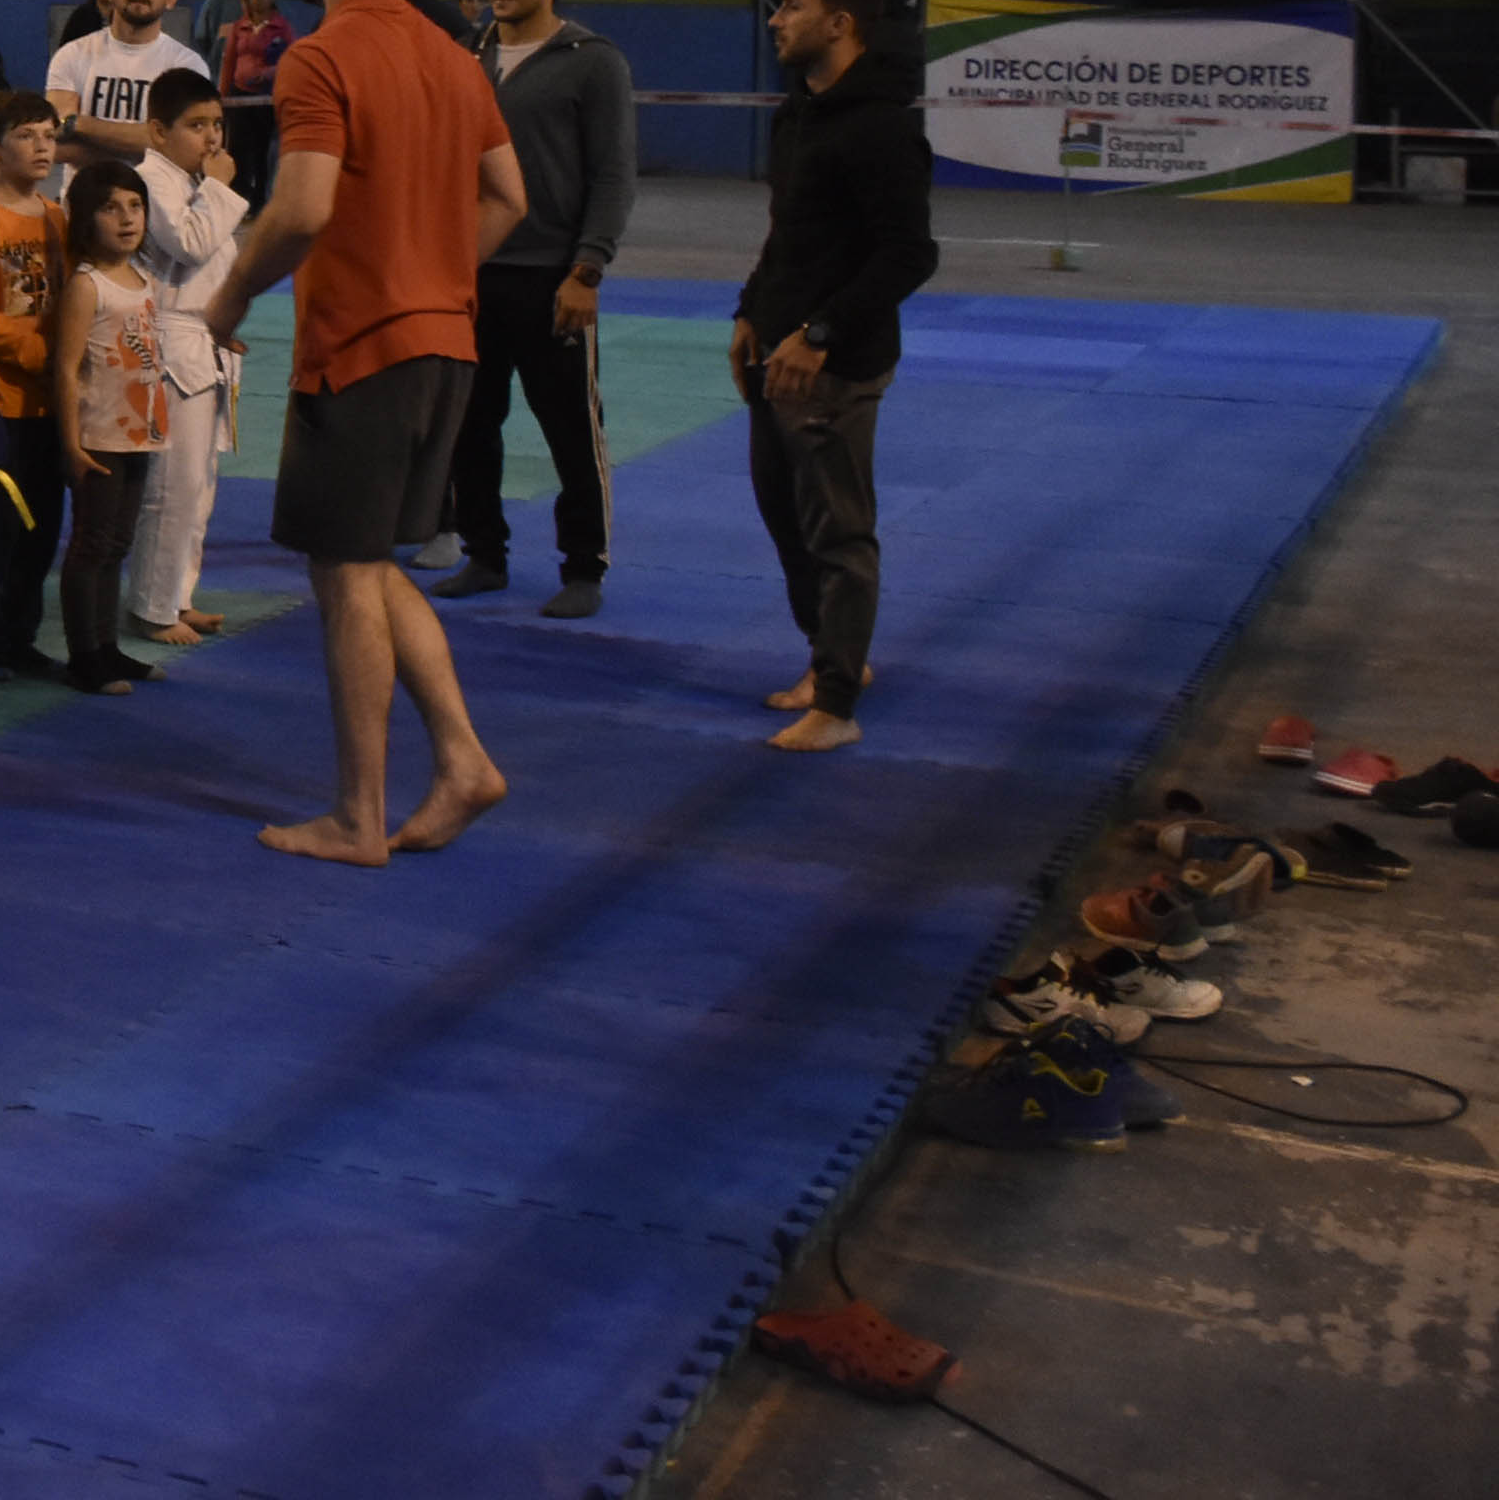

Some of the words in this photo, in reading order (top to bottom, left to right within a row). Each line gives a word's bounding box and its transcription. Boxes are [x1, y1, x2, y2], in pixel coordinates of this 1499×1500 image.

[965, 54, 1118, 83] DIRECCIÓN
[1128, 63, 1162, 84] DE
[1171, 64, 1311, 88] DEPORTES
[90, 76, 150, 121] FIAT
[1097, 91, 1119, 106] DE
[1125, 92, 1211, 108] GENERAL
[1217, 89, 1329, 112] RODRÍGUEZ
[1107, 136, 1185, 153] General
